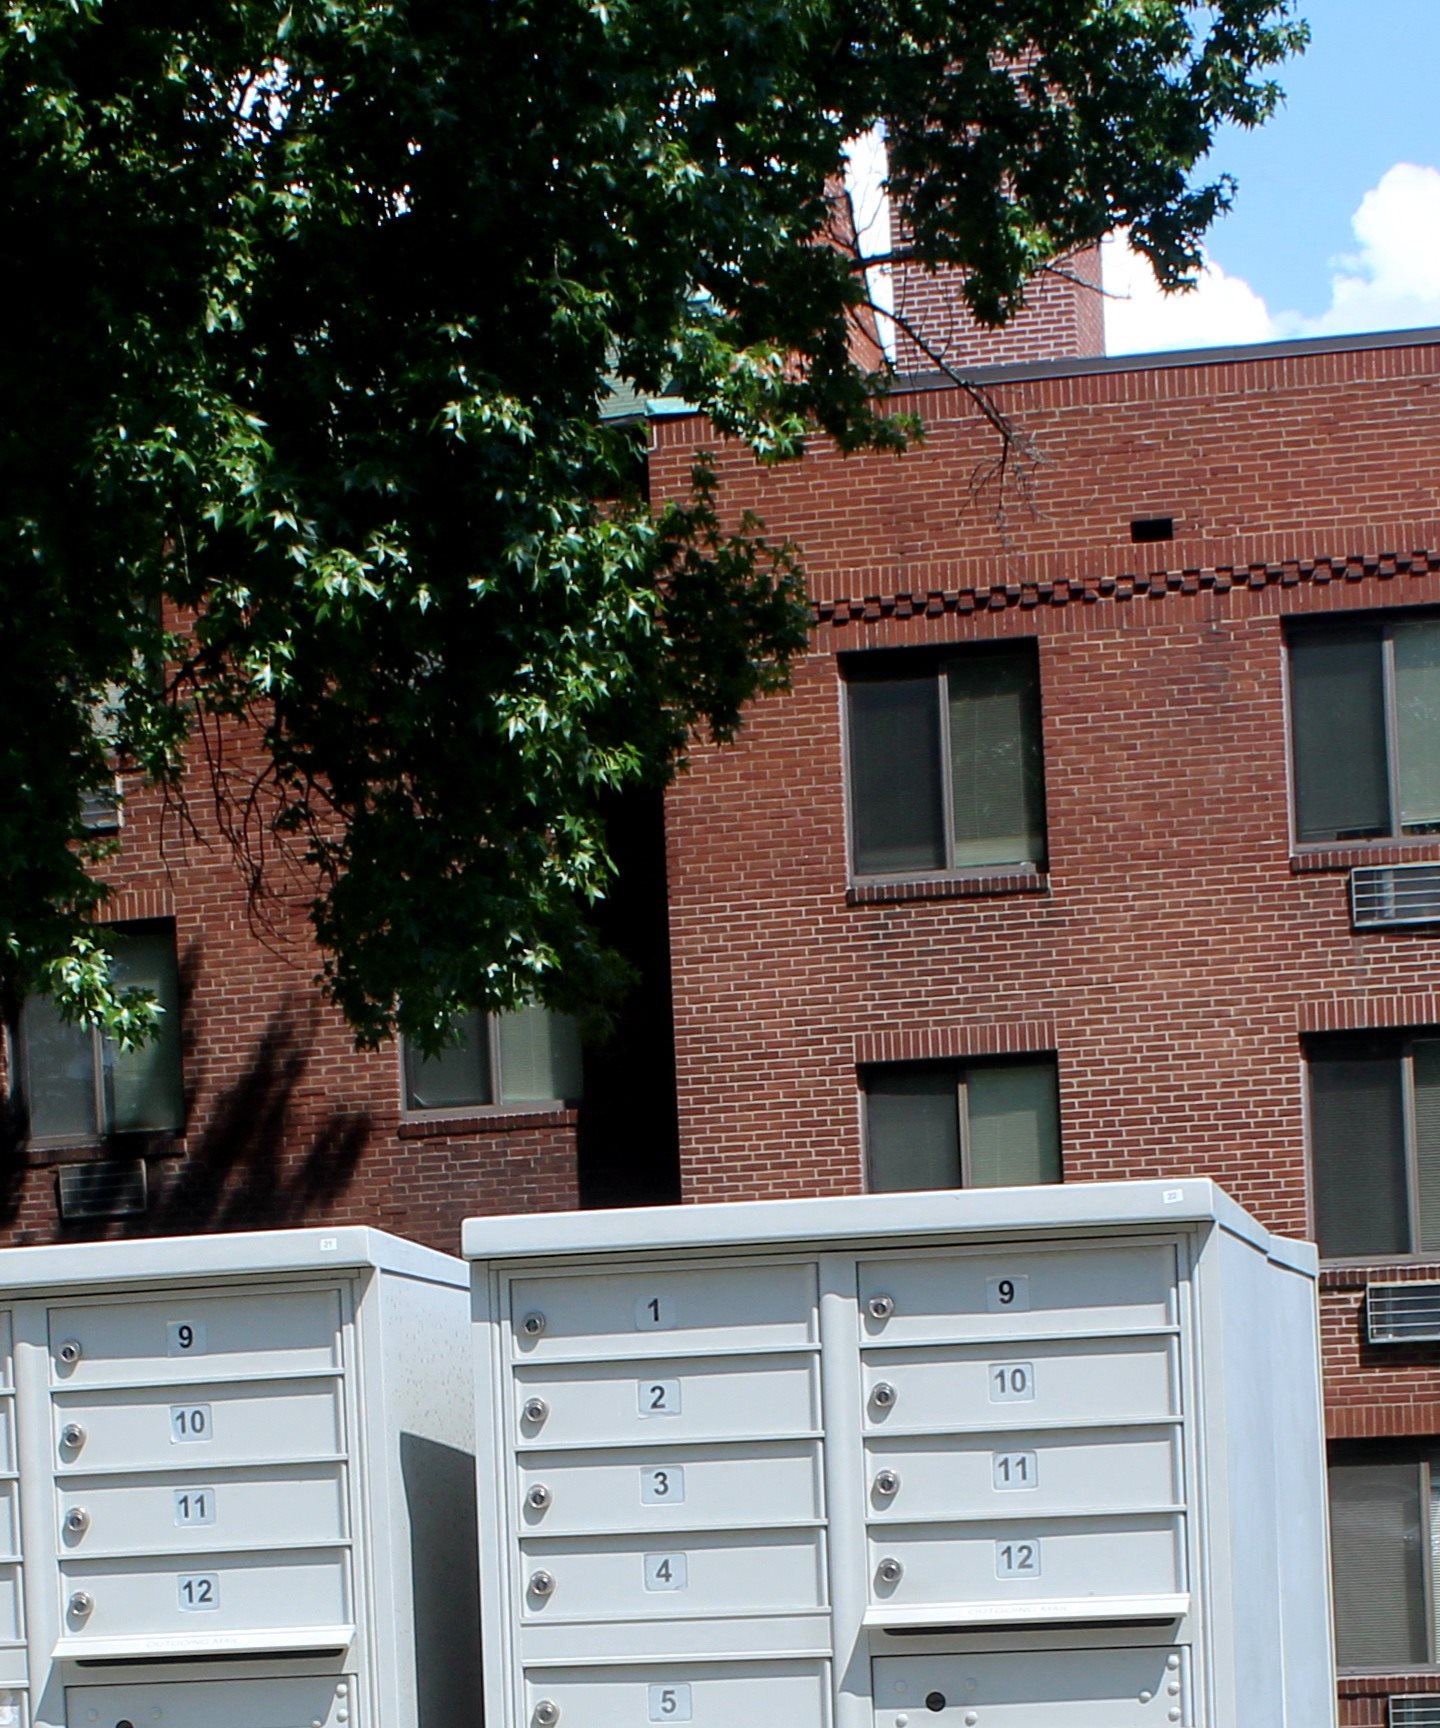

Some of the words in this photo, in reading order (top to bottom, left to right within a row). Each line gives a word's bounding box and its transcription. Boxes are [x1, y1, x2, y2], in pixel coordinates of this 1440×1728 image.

[998, 1280, 1015, 1304] 9
[648, 1298, 659, 1322] 1
[178, 1325, 193, 1349] 9
[993, 1368, 1026, 1393] 10
[650, 1385, 665, 1409] 2
[174, 1409, 205, 1434] 10
[997, 1456, 1027, 1482] 11
[654, 1471, 669, 1495] 3
[177, 1494, 205, 1518] 11
[1000, 1544, 1033, 1570] 12
[655, 1558, 672, 1583] 4
[182, 1579, 212, 1603] 12
[661, 1689, 676, 1714] 5
